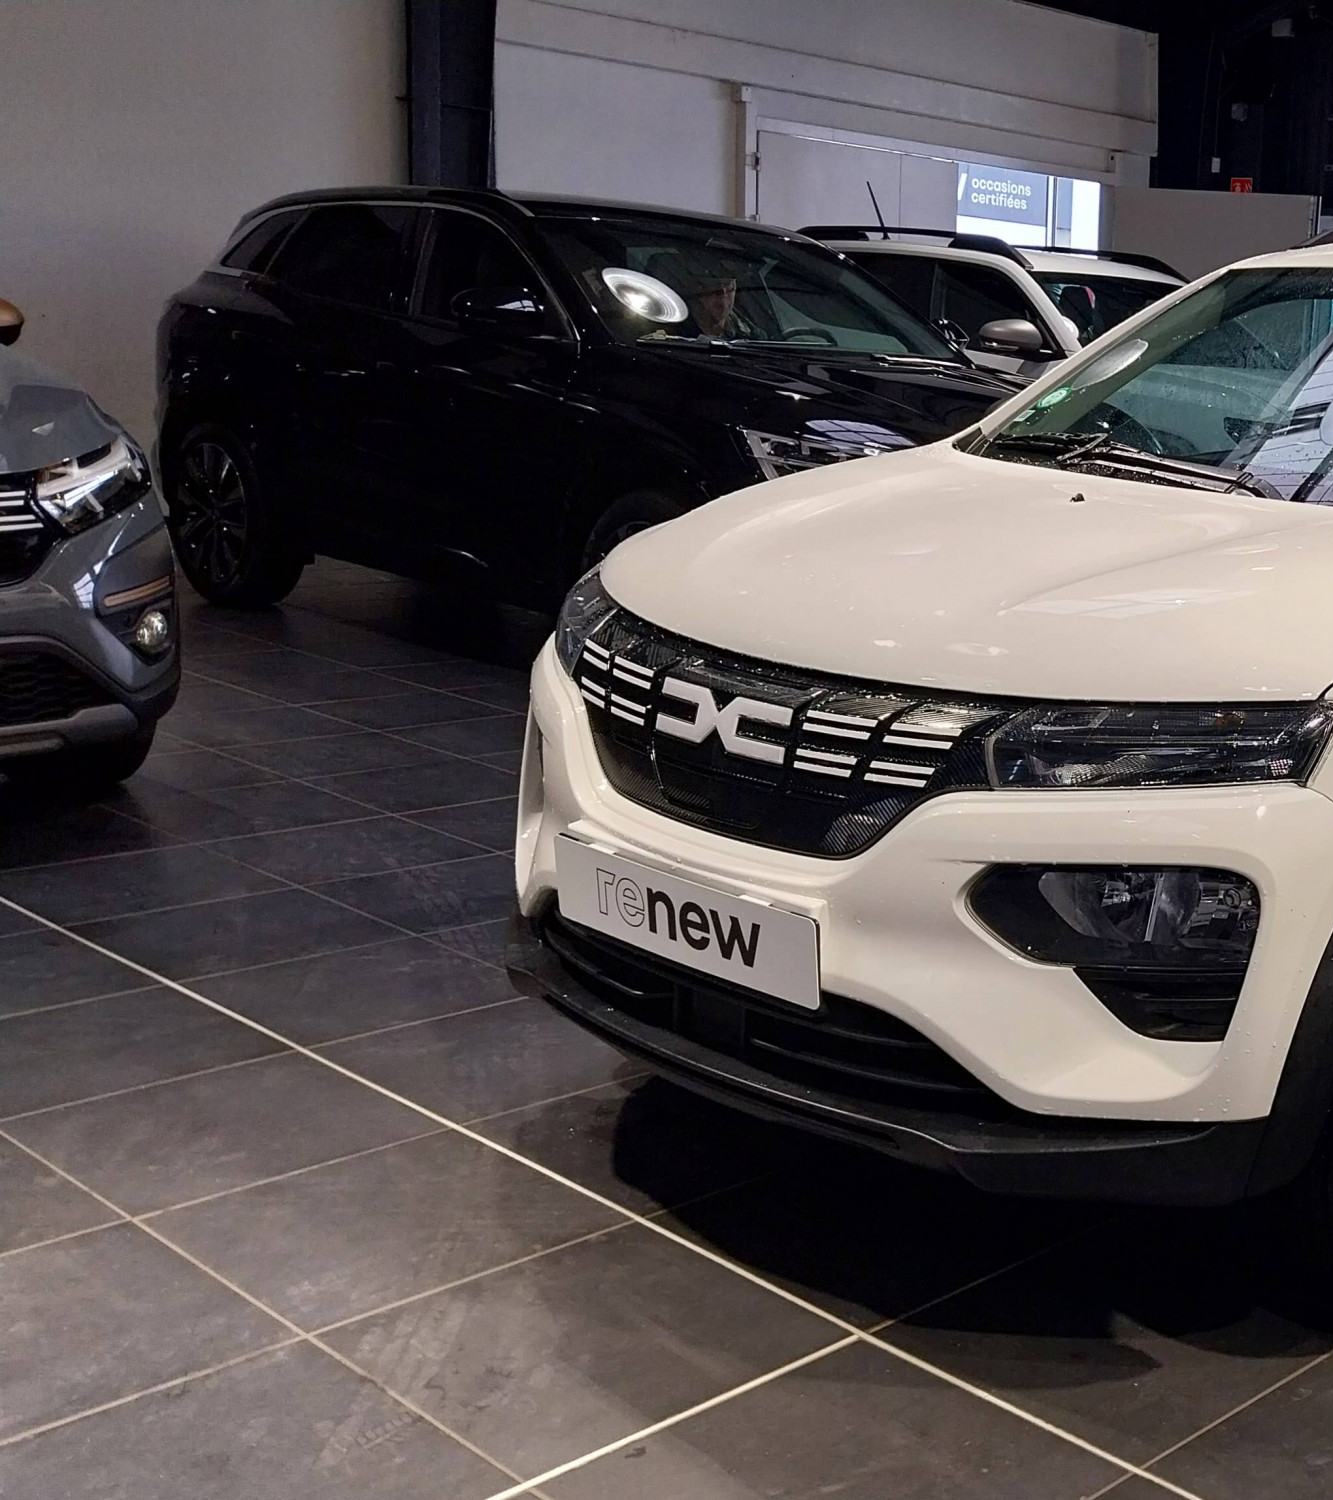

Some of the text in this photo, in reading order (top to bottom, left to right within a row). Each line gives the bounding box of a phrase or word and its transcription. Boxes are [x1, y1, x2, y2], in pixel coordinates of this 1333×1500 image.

[971, 178, 1031, 196] occasions
[971, 192, 1027, 210] certifiées
[596, 867, 761, 968] renew
